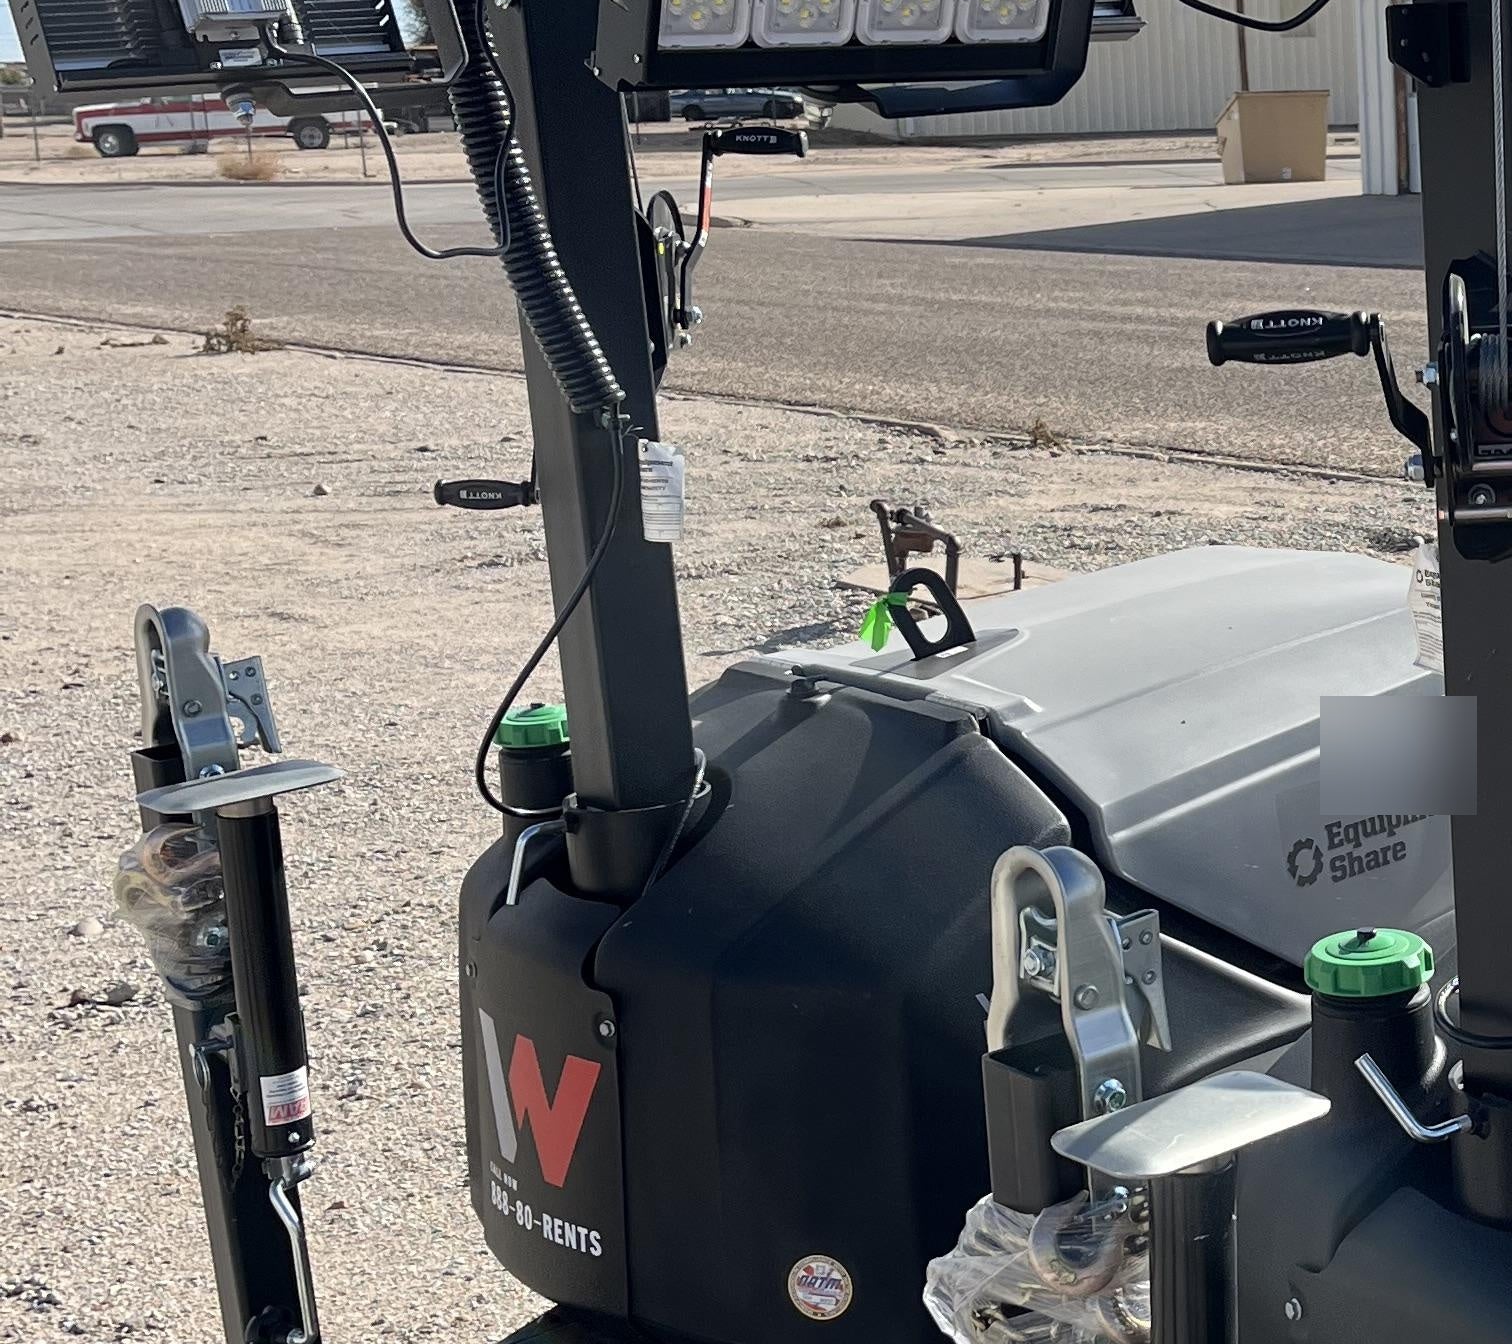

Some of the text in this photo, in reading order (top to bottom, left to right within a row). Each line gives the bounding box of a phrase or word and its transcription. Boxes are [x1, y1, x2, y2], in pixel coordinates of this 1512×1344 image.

[1265, 316, 1323, 330] KNOTT
[1325, 815, 1435, 850] Equip
[1329, 840, 1407, 883] Share
[491, 1180, 602, 1257] 888-80-RENTS
